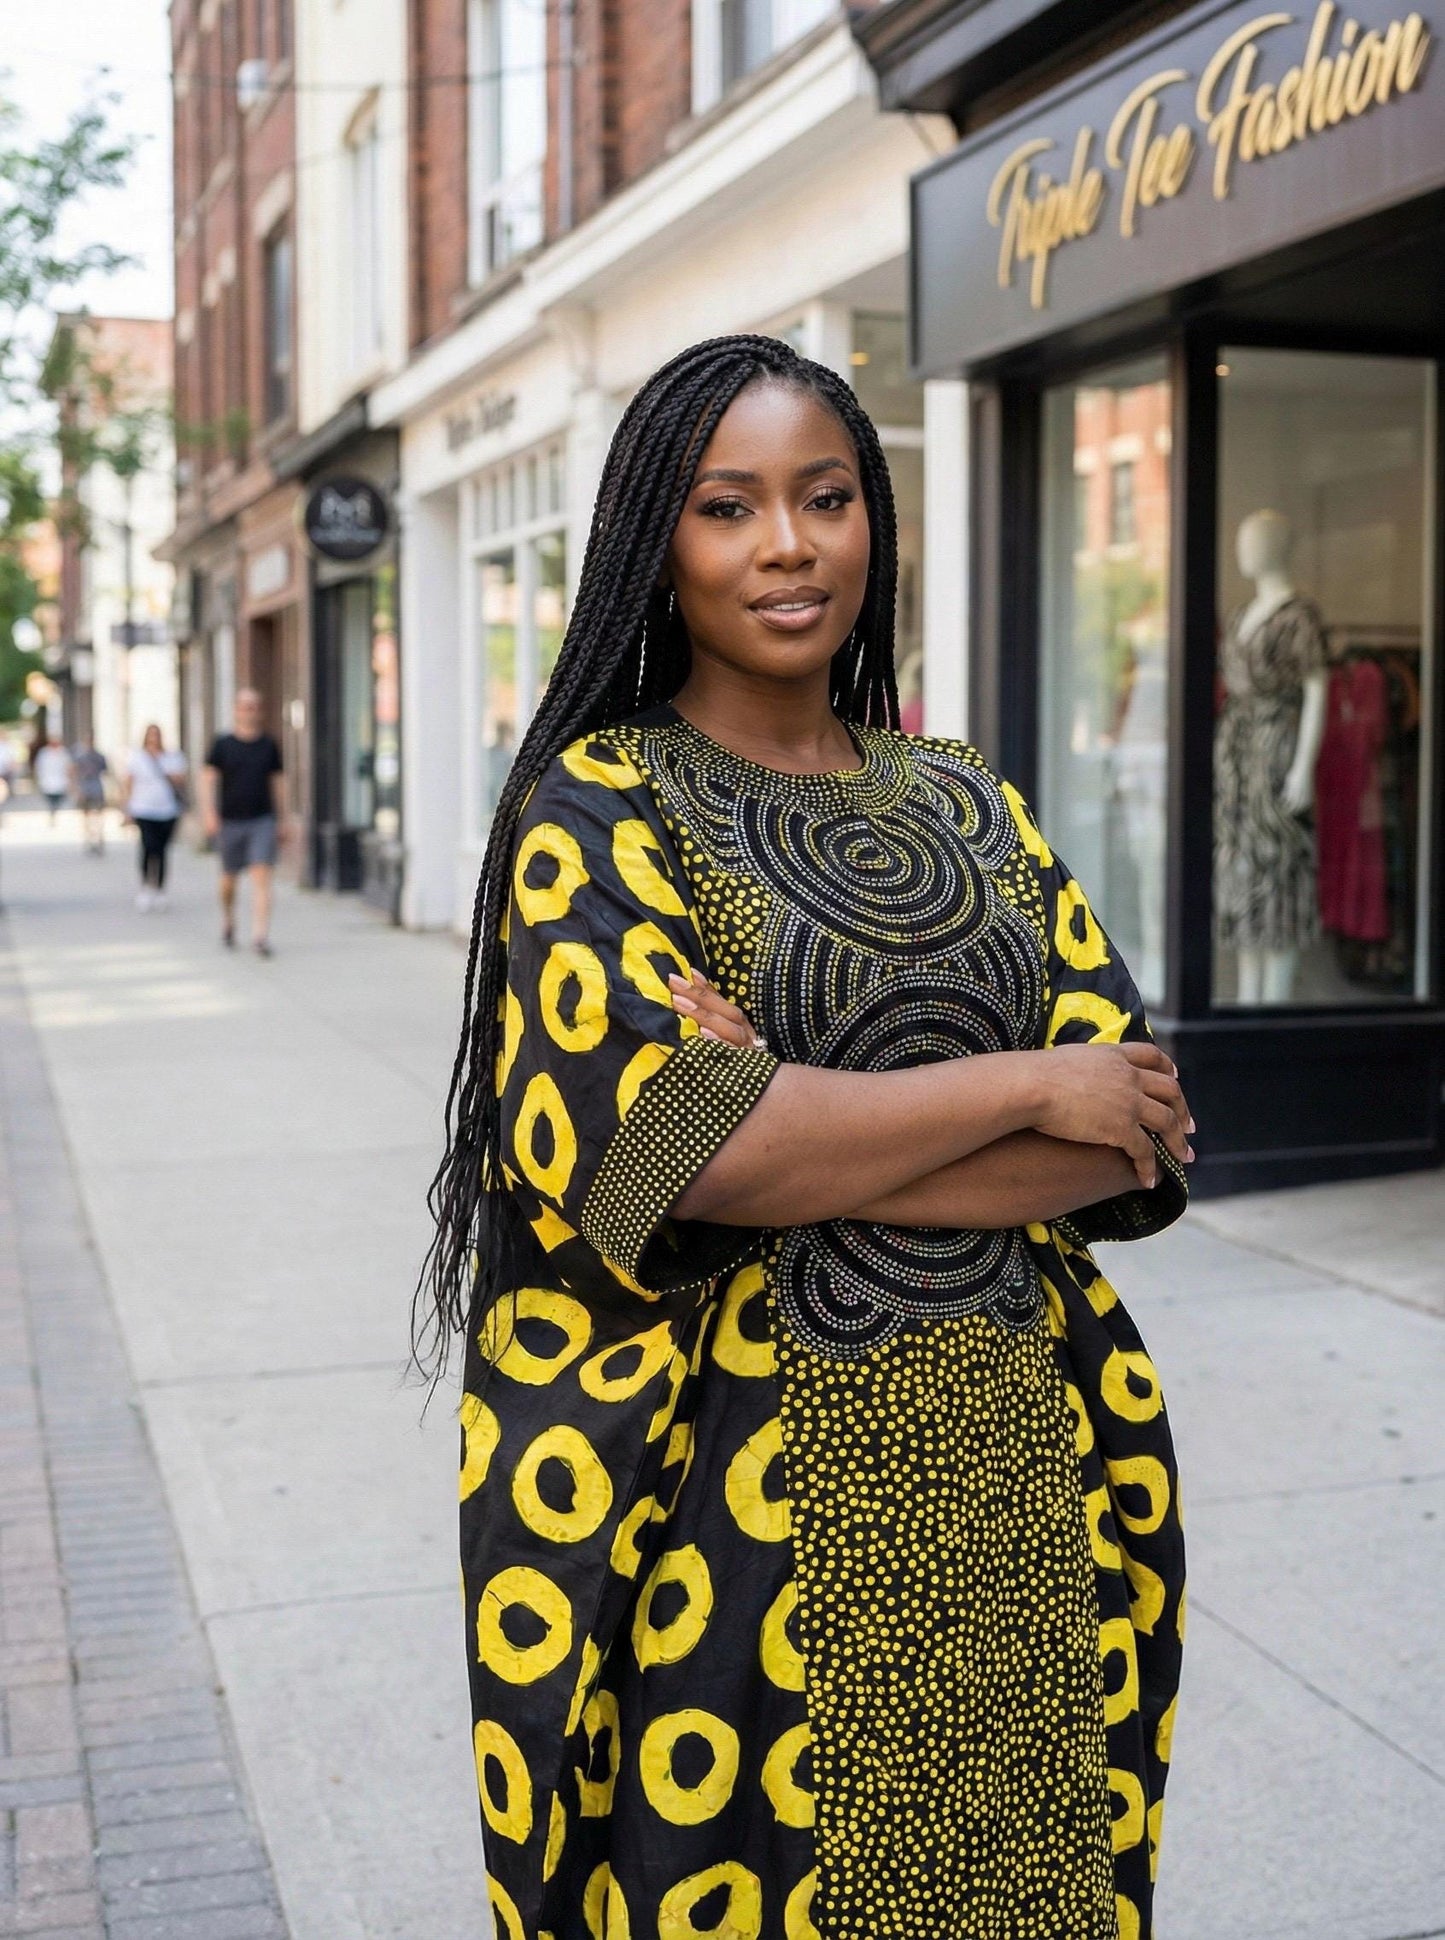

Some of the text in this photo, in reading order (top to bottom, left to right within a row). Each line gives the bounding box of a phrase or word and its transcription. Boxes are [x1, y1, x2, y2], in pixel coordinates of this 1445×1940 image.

[986, 0, 1430, 309] Triple Tee Fashion
